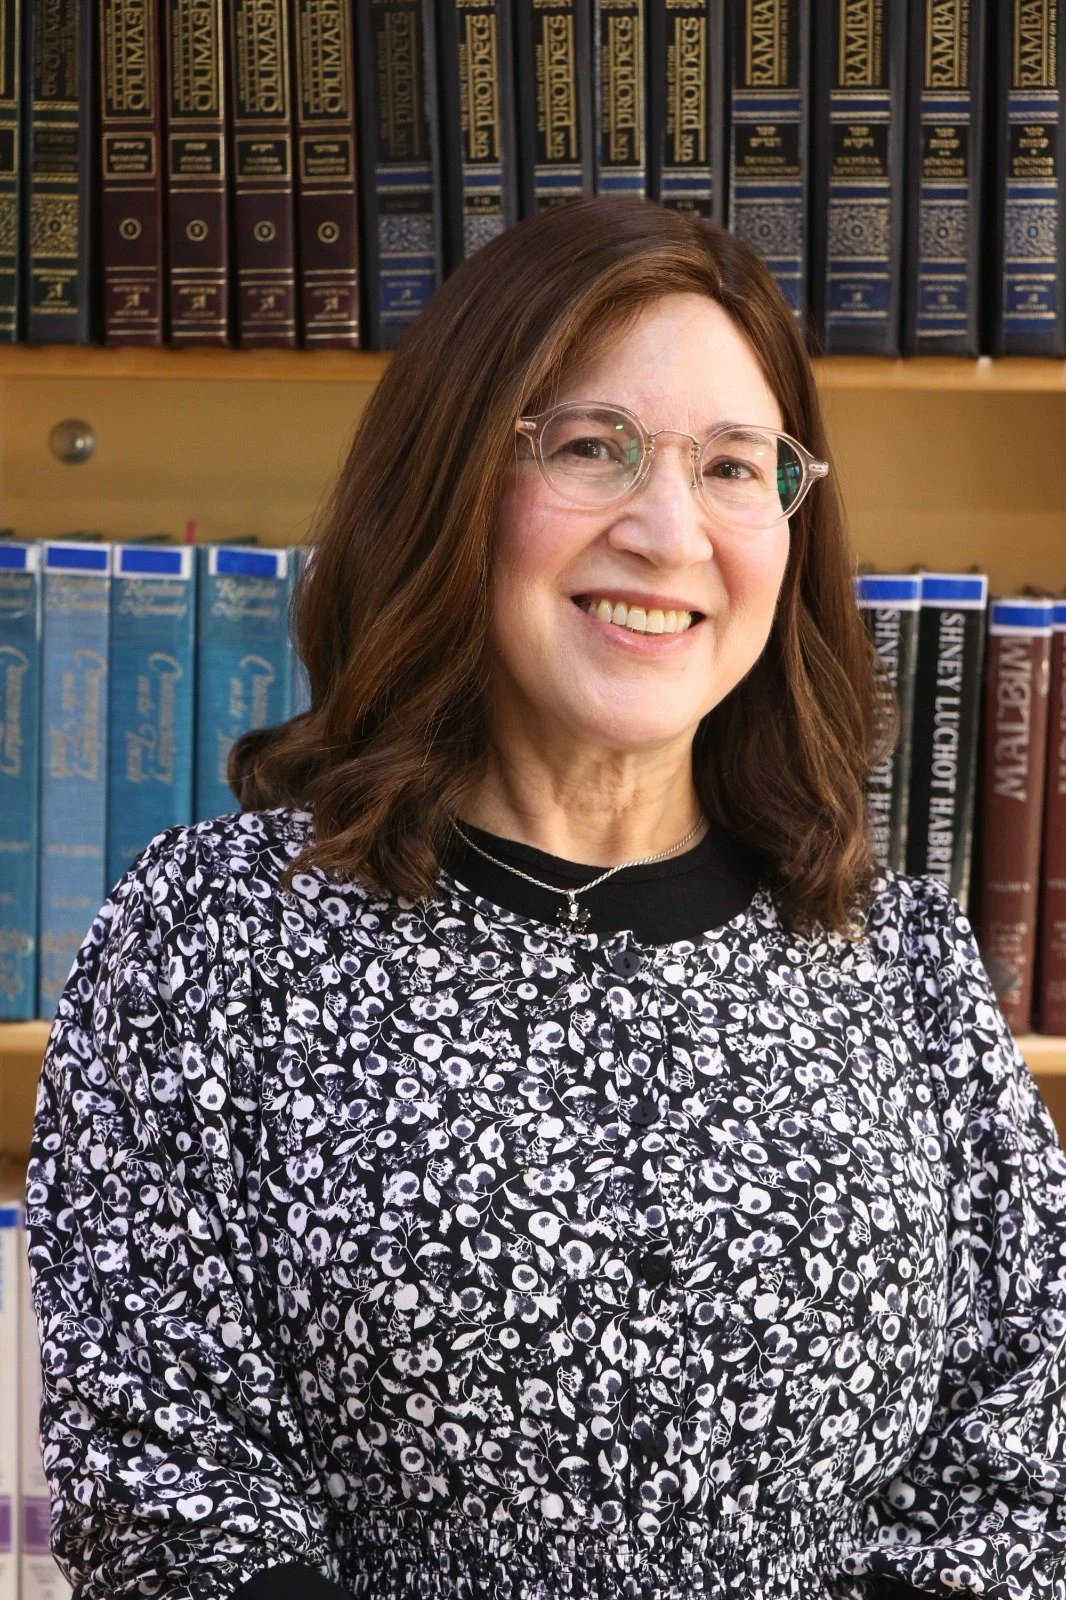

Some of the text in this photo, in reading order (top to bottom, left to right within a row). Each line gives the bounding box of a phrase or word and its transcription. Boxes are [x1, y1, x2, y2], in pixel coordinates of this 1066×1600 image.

[472, 14, 496, 126] prophets
[549, 15, 574, 127] prophets
[679, 17, 702, 130] prophets
[936, 611, 966, 693] SHNEY
[930, 696, 960, 794] LUCHOT
[994, 635, 1034, 802] MALBIM
